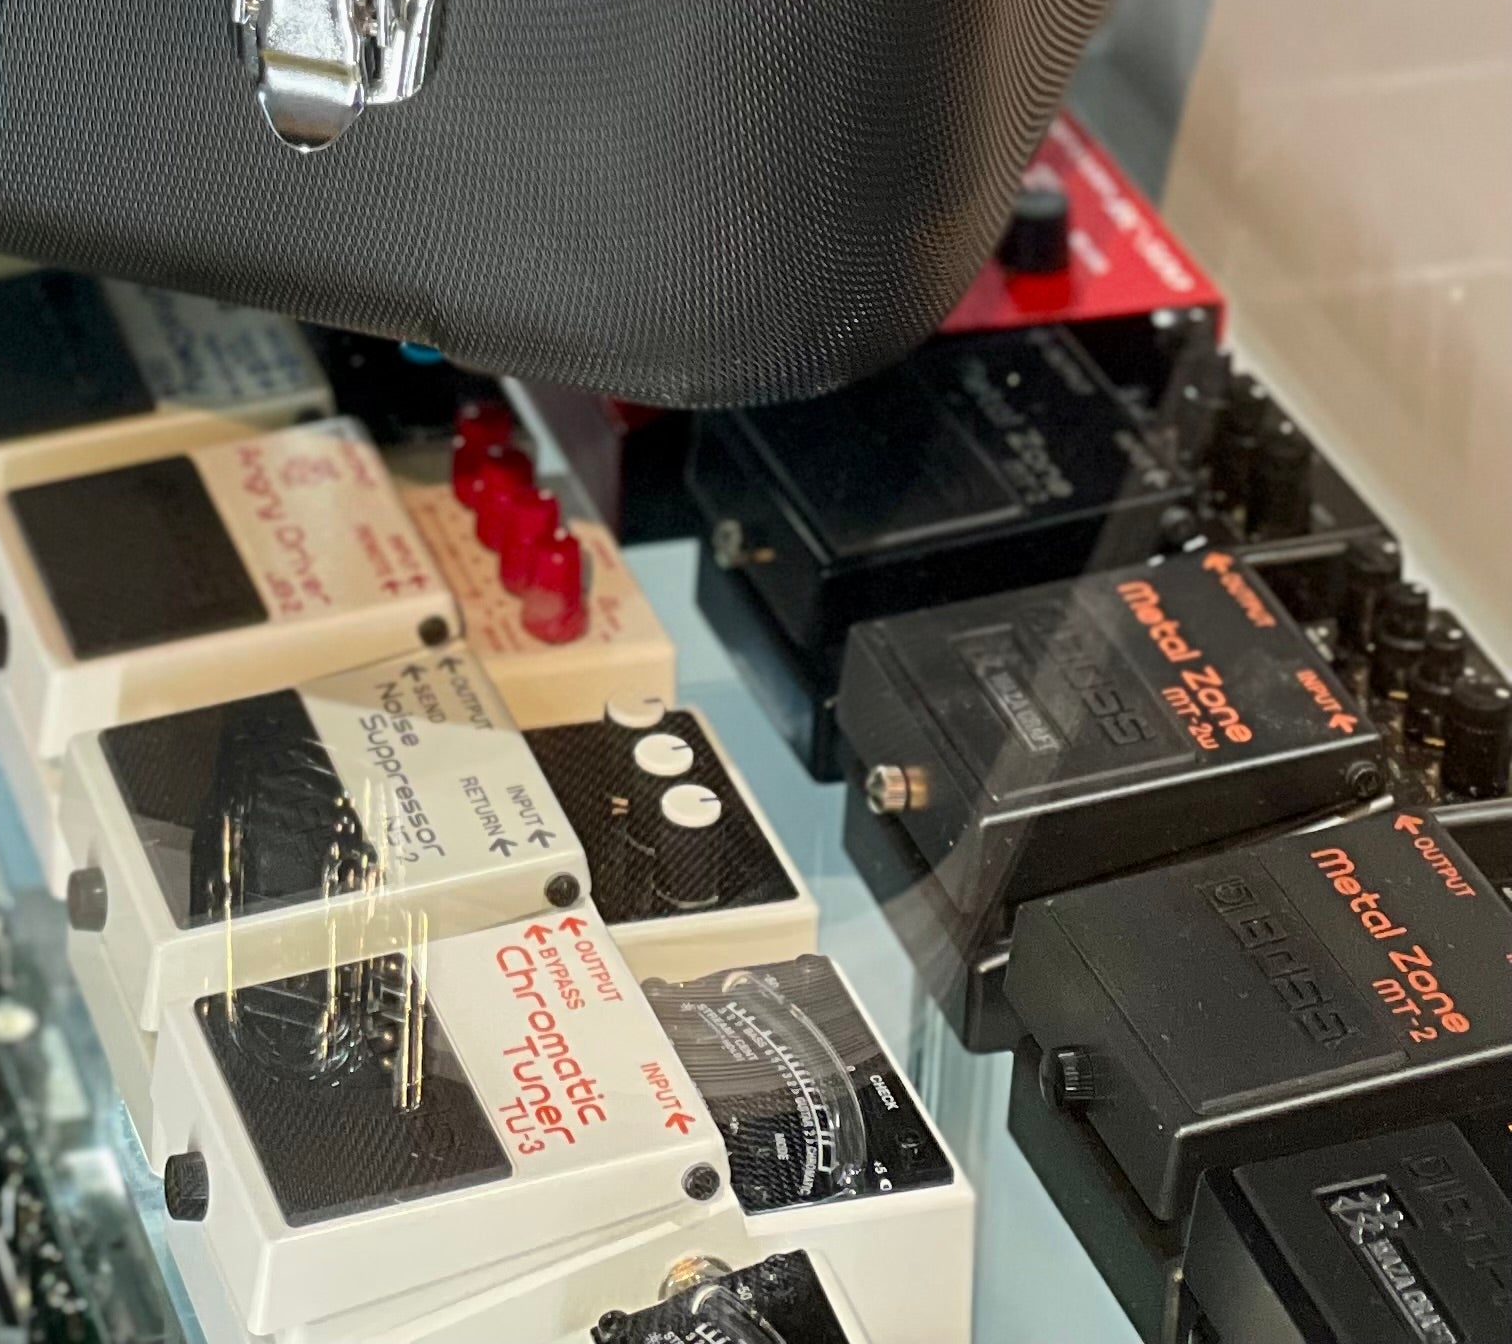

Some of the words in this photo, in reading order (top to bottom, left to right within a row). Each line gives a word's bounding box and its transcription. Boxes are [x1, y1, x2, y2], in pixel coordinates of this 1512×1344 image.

[1117, 579, 1203, 663] Metal
[1181, 665, 1253, 743] Zone
[1296, 668, 1343, 712] INPUT
[374, 681, 420, 748] Noise
[412, 682, 447, 724] SEND
[450, 675, 494, 731] OUTPUT
[359, 713, 446, 857] Suppressor
[459, 775, 506, 837] RETURN
[506, 784, 545, 829] INPUT
[1413, 835, 1476, 897] OUTPUT
[574, 939, 624, 1002] OUTPUT
[1310, 847, 1408, 940] Metal
[1388, 944, 1471, 1035] Zone
[538, 946, 587, 1010] BYPASS
[495, 945, 608, 1126] Chromatic
[1372, 978, 1438, 1043] MT-2
[502, 1035, 576, 1145] Tuner
[639, 1061, 683, 1111] INPUT
[869, 1074, 900, 1111] CHECK
[498, 1096, 546, 1155] TU-3
